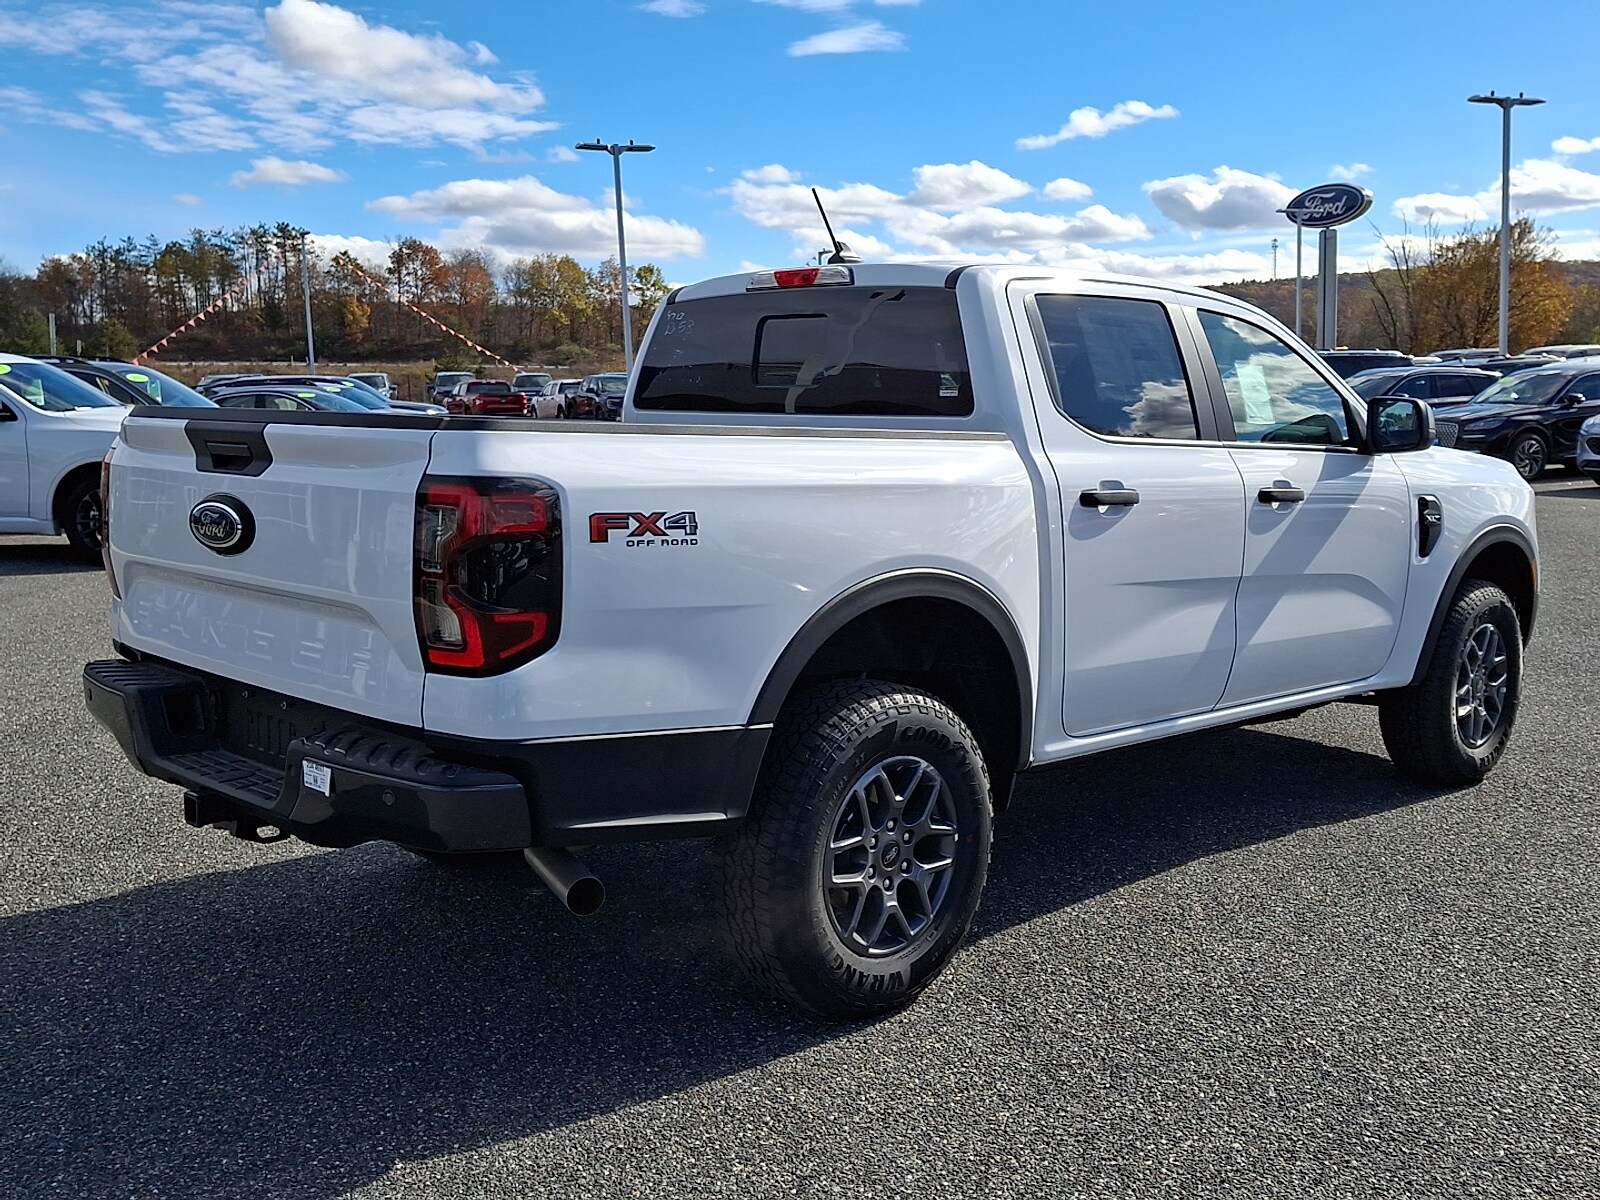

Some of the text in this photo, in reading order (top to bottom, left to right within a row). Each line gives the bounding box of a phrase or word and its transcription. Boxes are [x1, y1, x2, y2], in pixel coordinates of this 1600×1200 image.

[1301, 191, 1348, 220] Ford
[195, 510, 228, 538] Ford
[589, 511, 698, 543] FX4
[626, 538, 698, 547] OFF ROAD
